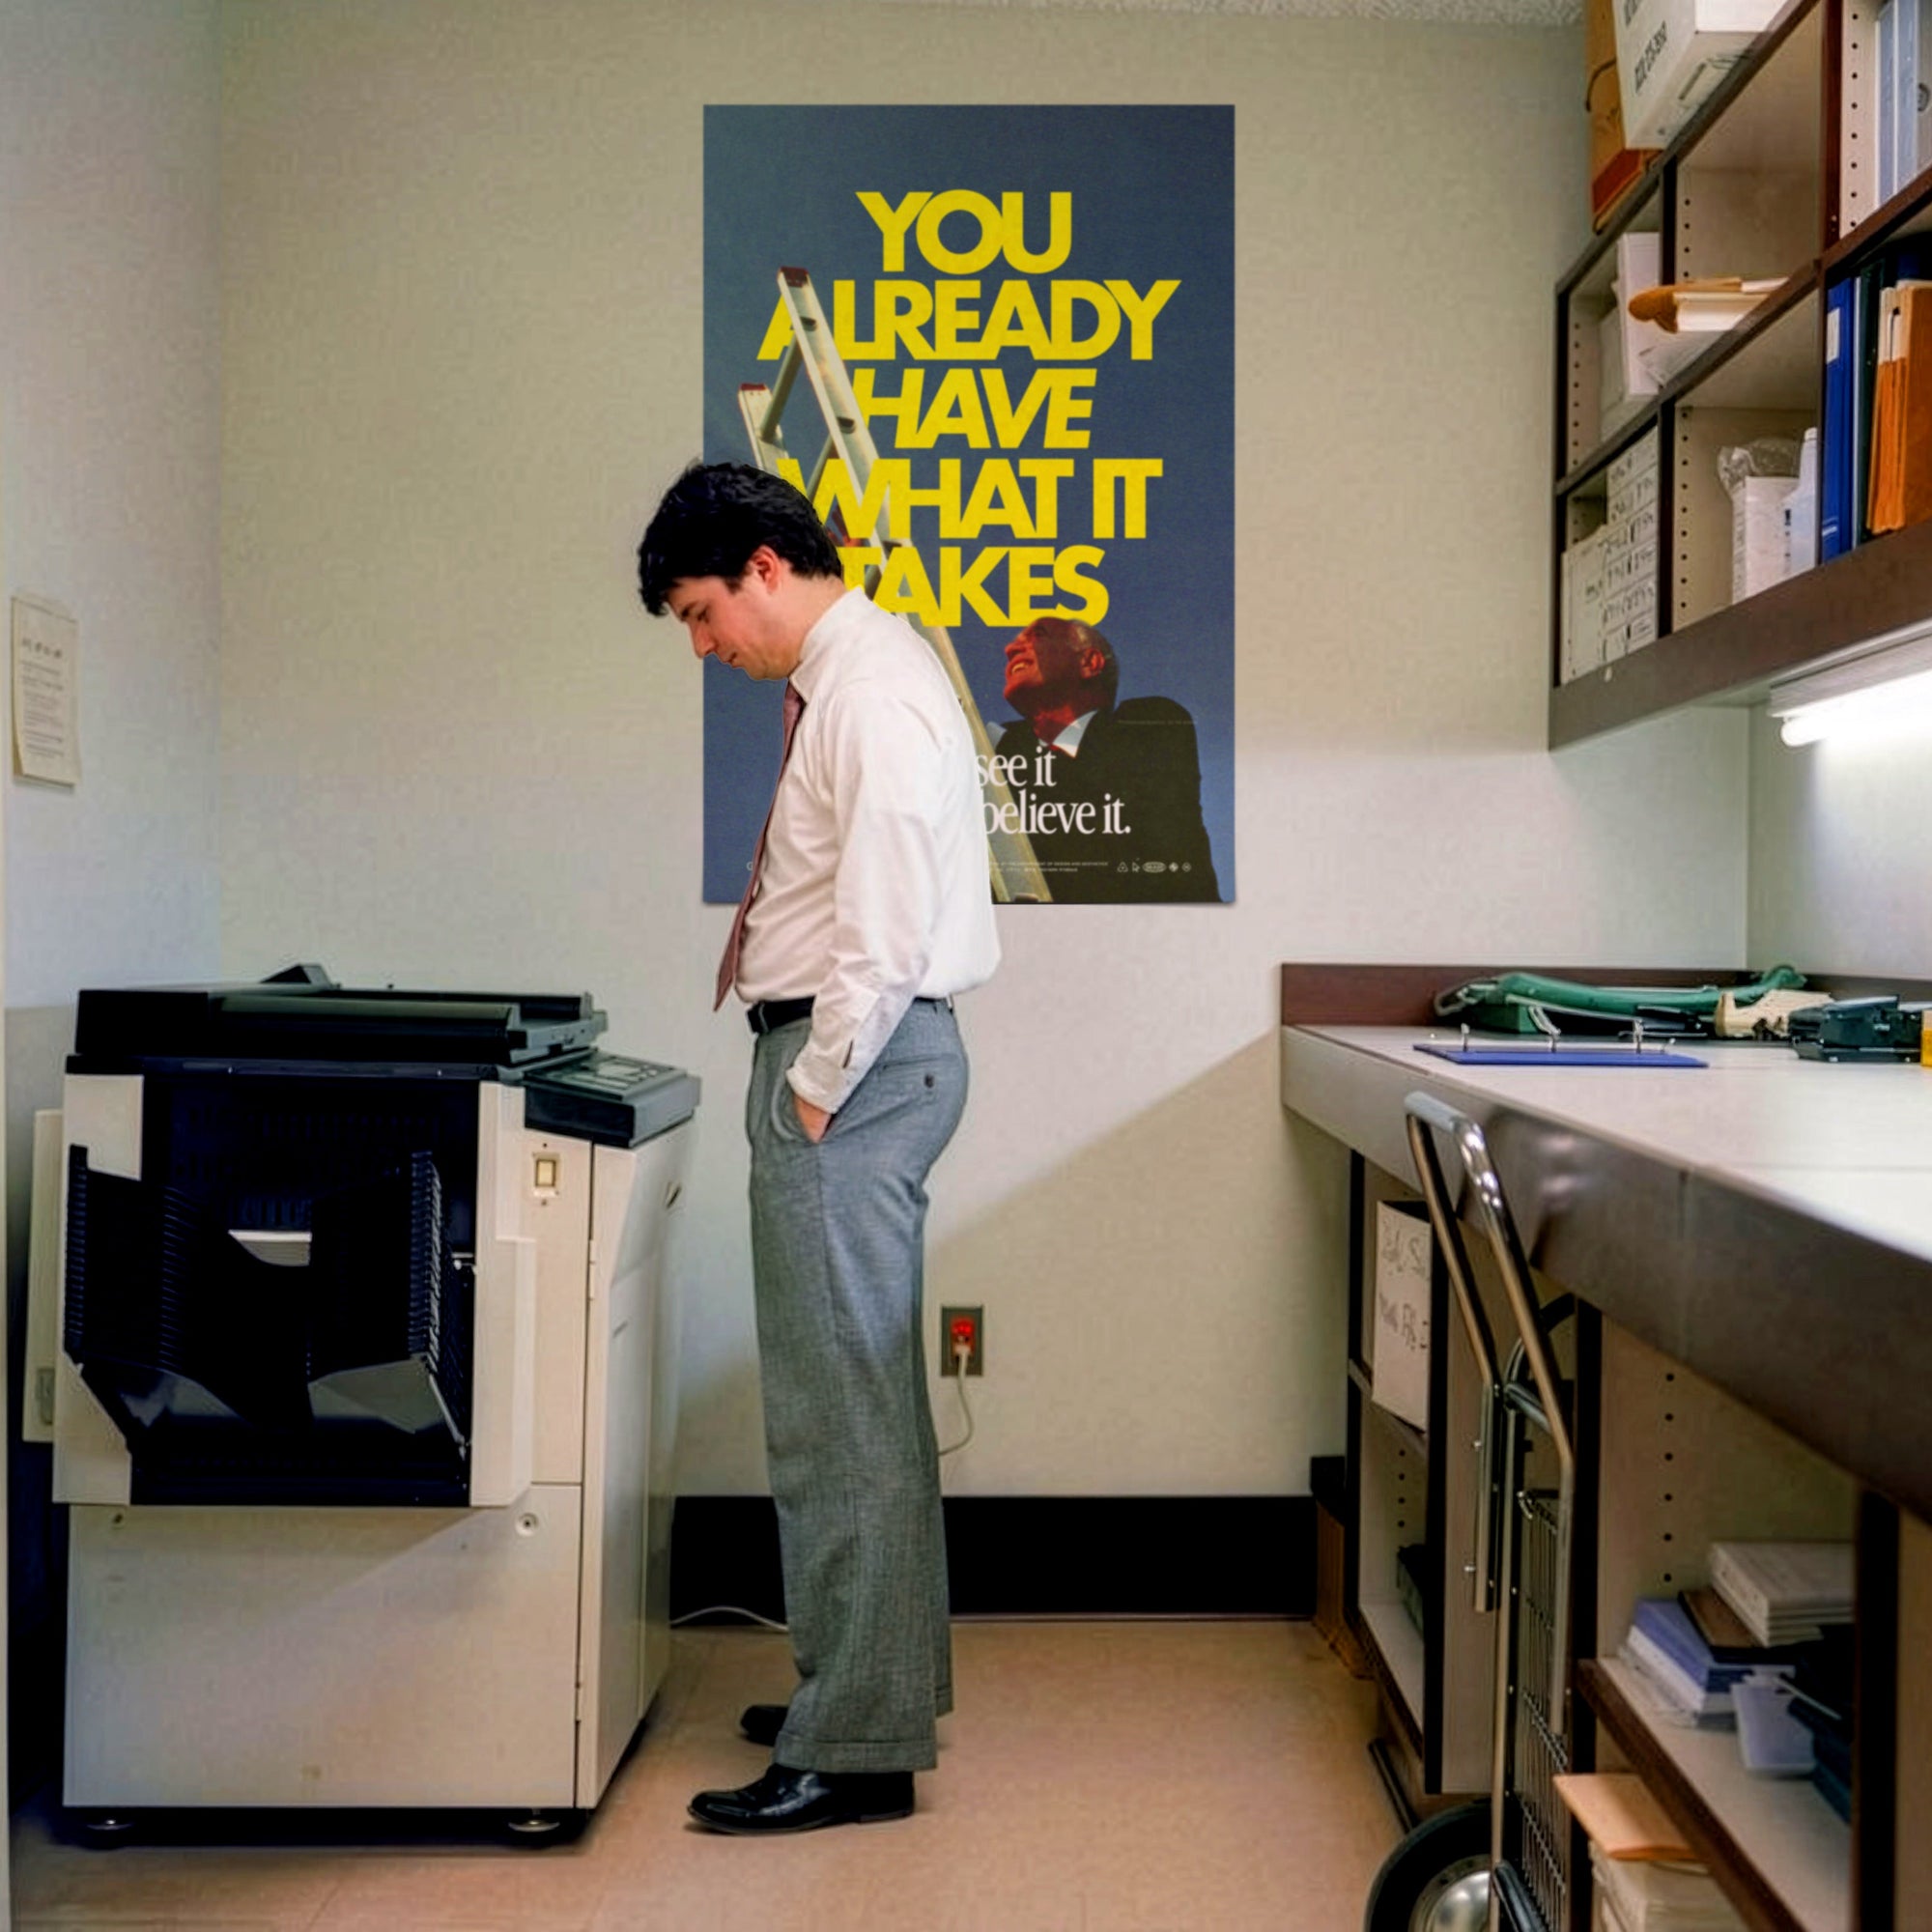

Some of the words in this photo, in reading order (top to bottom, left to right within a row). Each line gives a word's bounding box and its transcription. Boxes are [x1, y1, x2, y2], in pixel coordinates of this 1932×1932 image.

[856, 189, 1072, 274] YOU
[851, 368, 1097, 448] HAVE
[776, 458, 1074, 539] WHAT
[1093, 458, 1163, 539] IT
[837, 544, 1110, 628] TAKES
[976, 753, 1028, 787] see
[1034, 745, 1058, 787] it
[1102, 792, 1132, 835] it.
